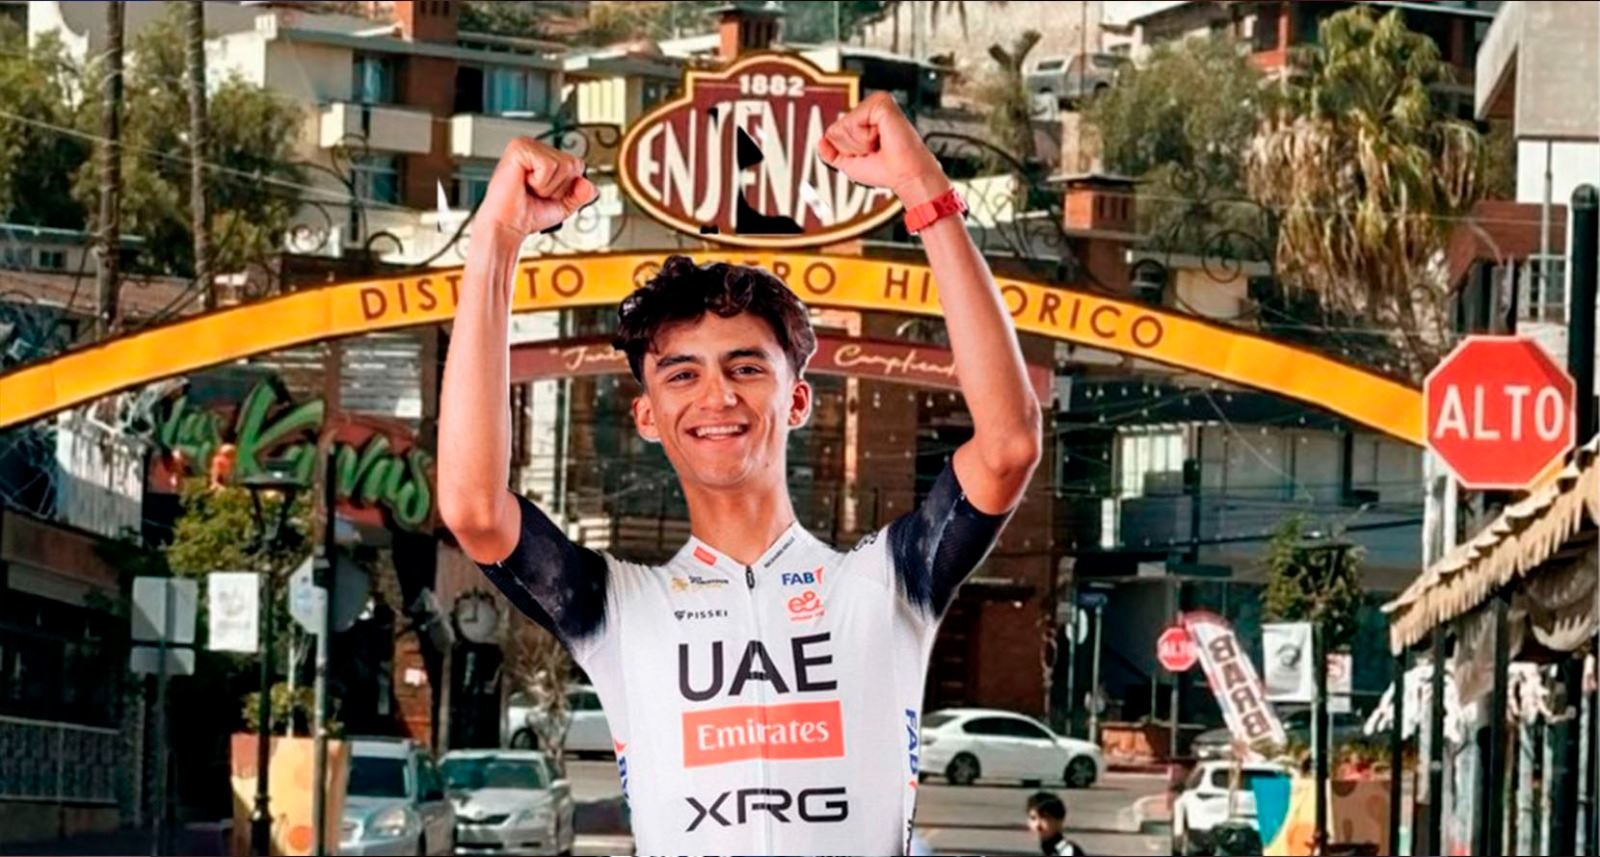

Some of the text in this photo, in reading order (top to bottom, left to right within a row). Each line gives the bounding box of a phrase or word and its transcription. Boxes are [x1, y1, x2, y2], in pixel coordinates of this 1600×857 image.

[740, 75, 805, 97] 1882
[361, 264, 584, 320] DISTTO
[884, 267, 1163, 349] HIORICO
[1434, 384, 1565, 442] ALTO
[782, 572, 815, 586] FAB
[678, 631, 838, 702] UAE
[697, 717, 830, 750] Emirates
[685, 786, 849, 832] XRG
